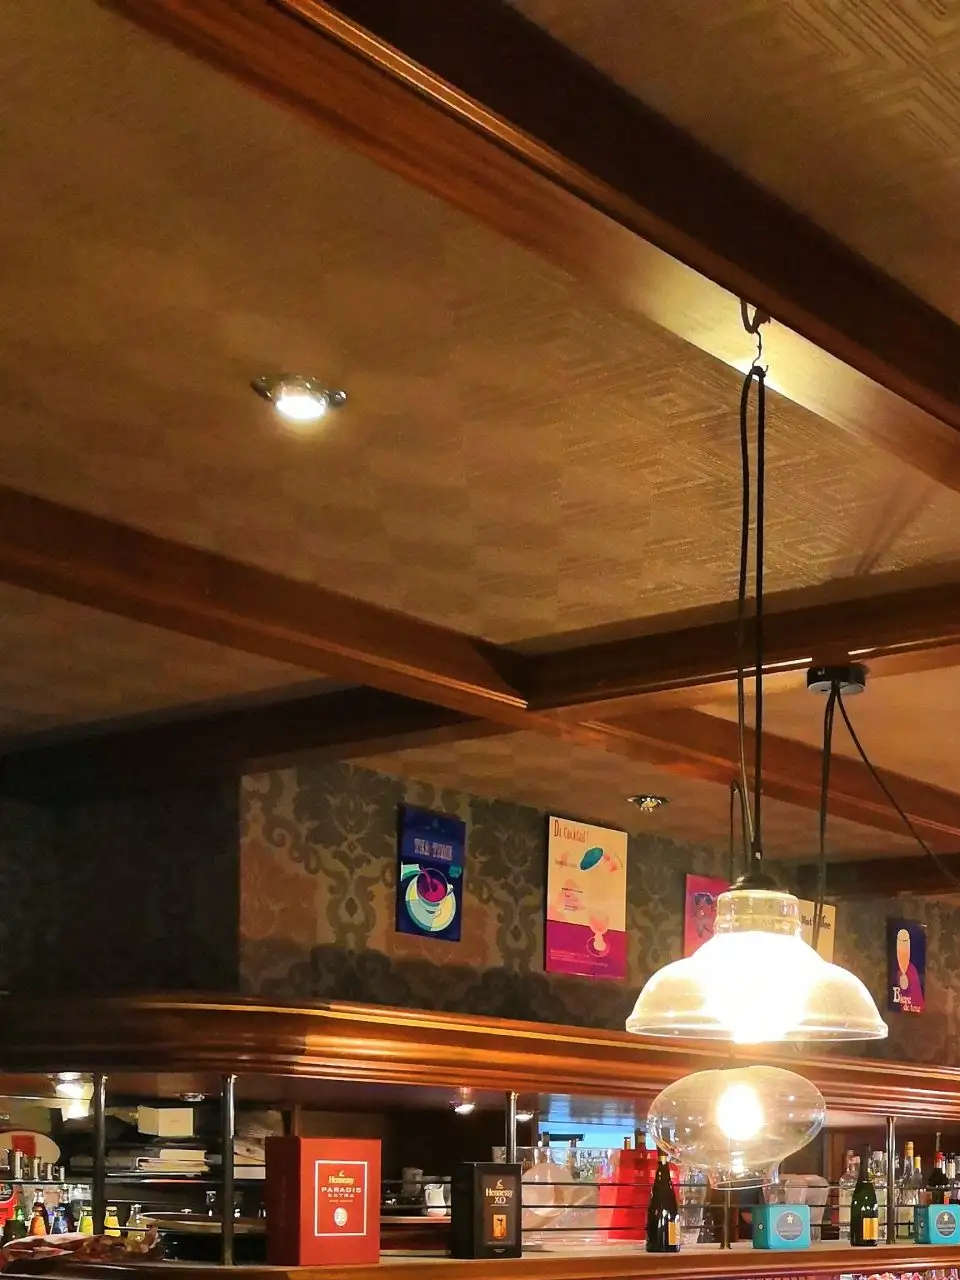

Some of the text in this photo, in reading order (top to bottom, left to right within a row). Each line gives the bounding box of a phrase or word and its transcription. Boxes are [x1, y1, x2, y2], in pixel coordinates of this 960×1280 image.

[328, 1175, 354, 1185] Hennessy
[321, 1186, 362, 1194] PARADIS
[485, 1187, 513, 1198] Hennessy
